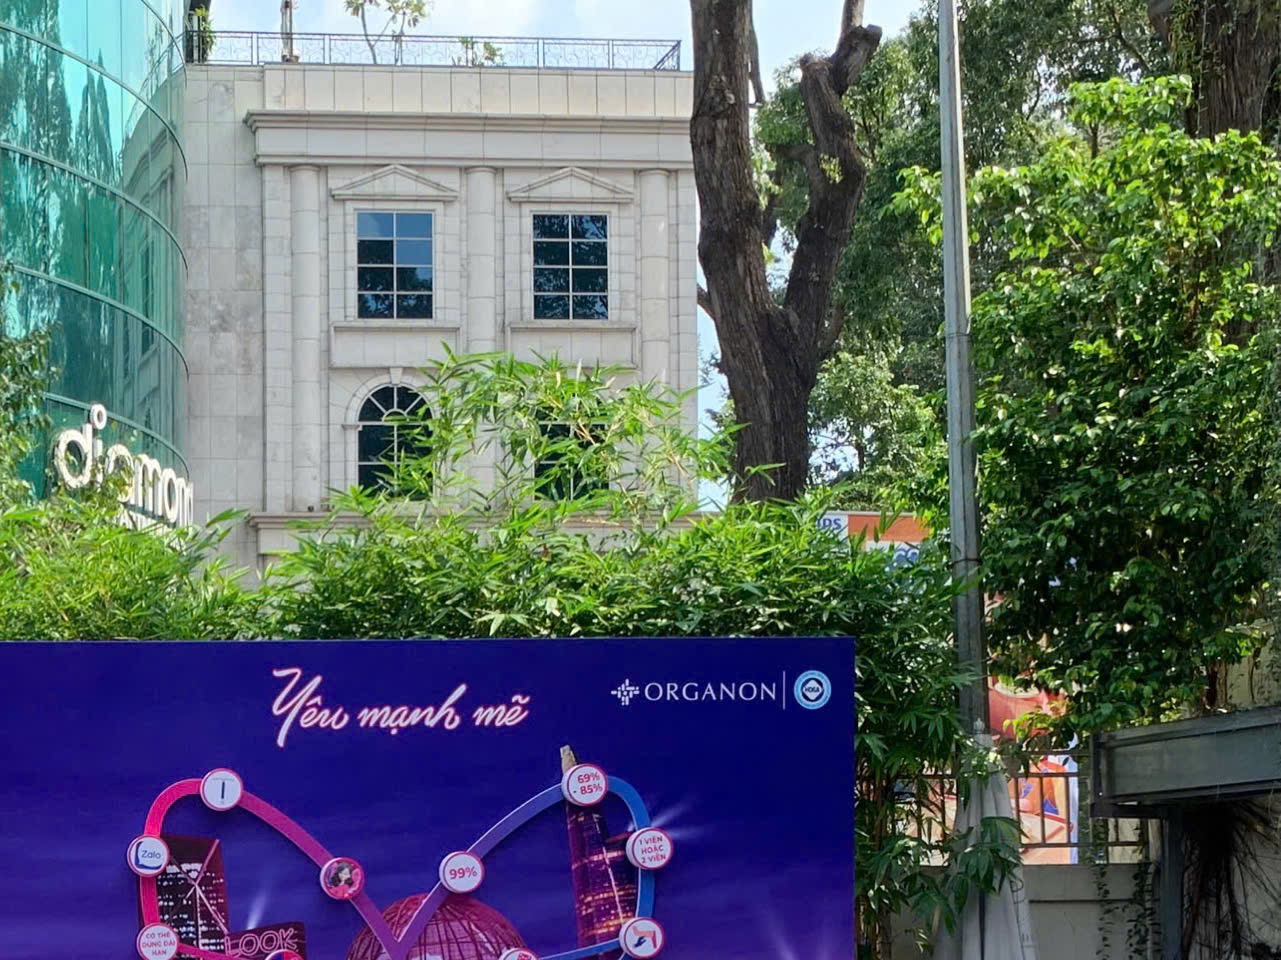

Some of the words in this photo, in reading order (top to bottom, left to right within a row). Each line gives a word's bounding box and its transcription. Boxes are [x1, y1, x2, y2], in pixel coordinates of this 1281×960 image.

[644, 682, 776, 701] ORGANON
[272, 667, 349, 748] Yêu
[357, 683, 467, 735] mạnh
[472, 694, 531, 727] mẽ
[577, 771, 600, 783] 69%
[580, 783, 603, 795] 85%
[141, 849, 162, 860] Zalo
[449, 867, 478, 880] 99%
[224, 927, 297, 958] LOOK
